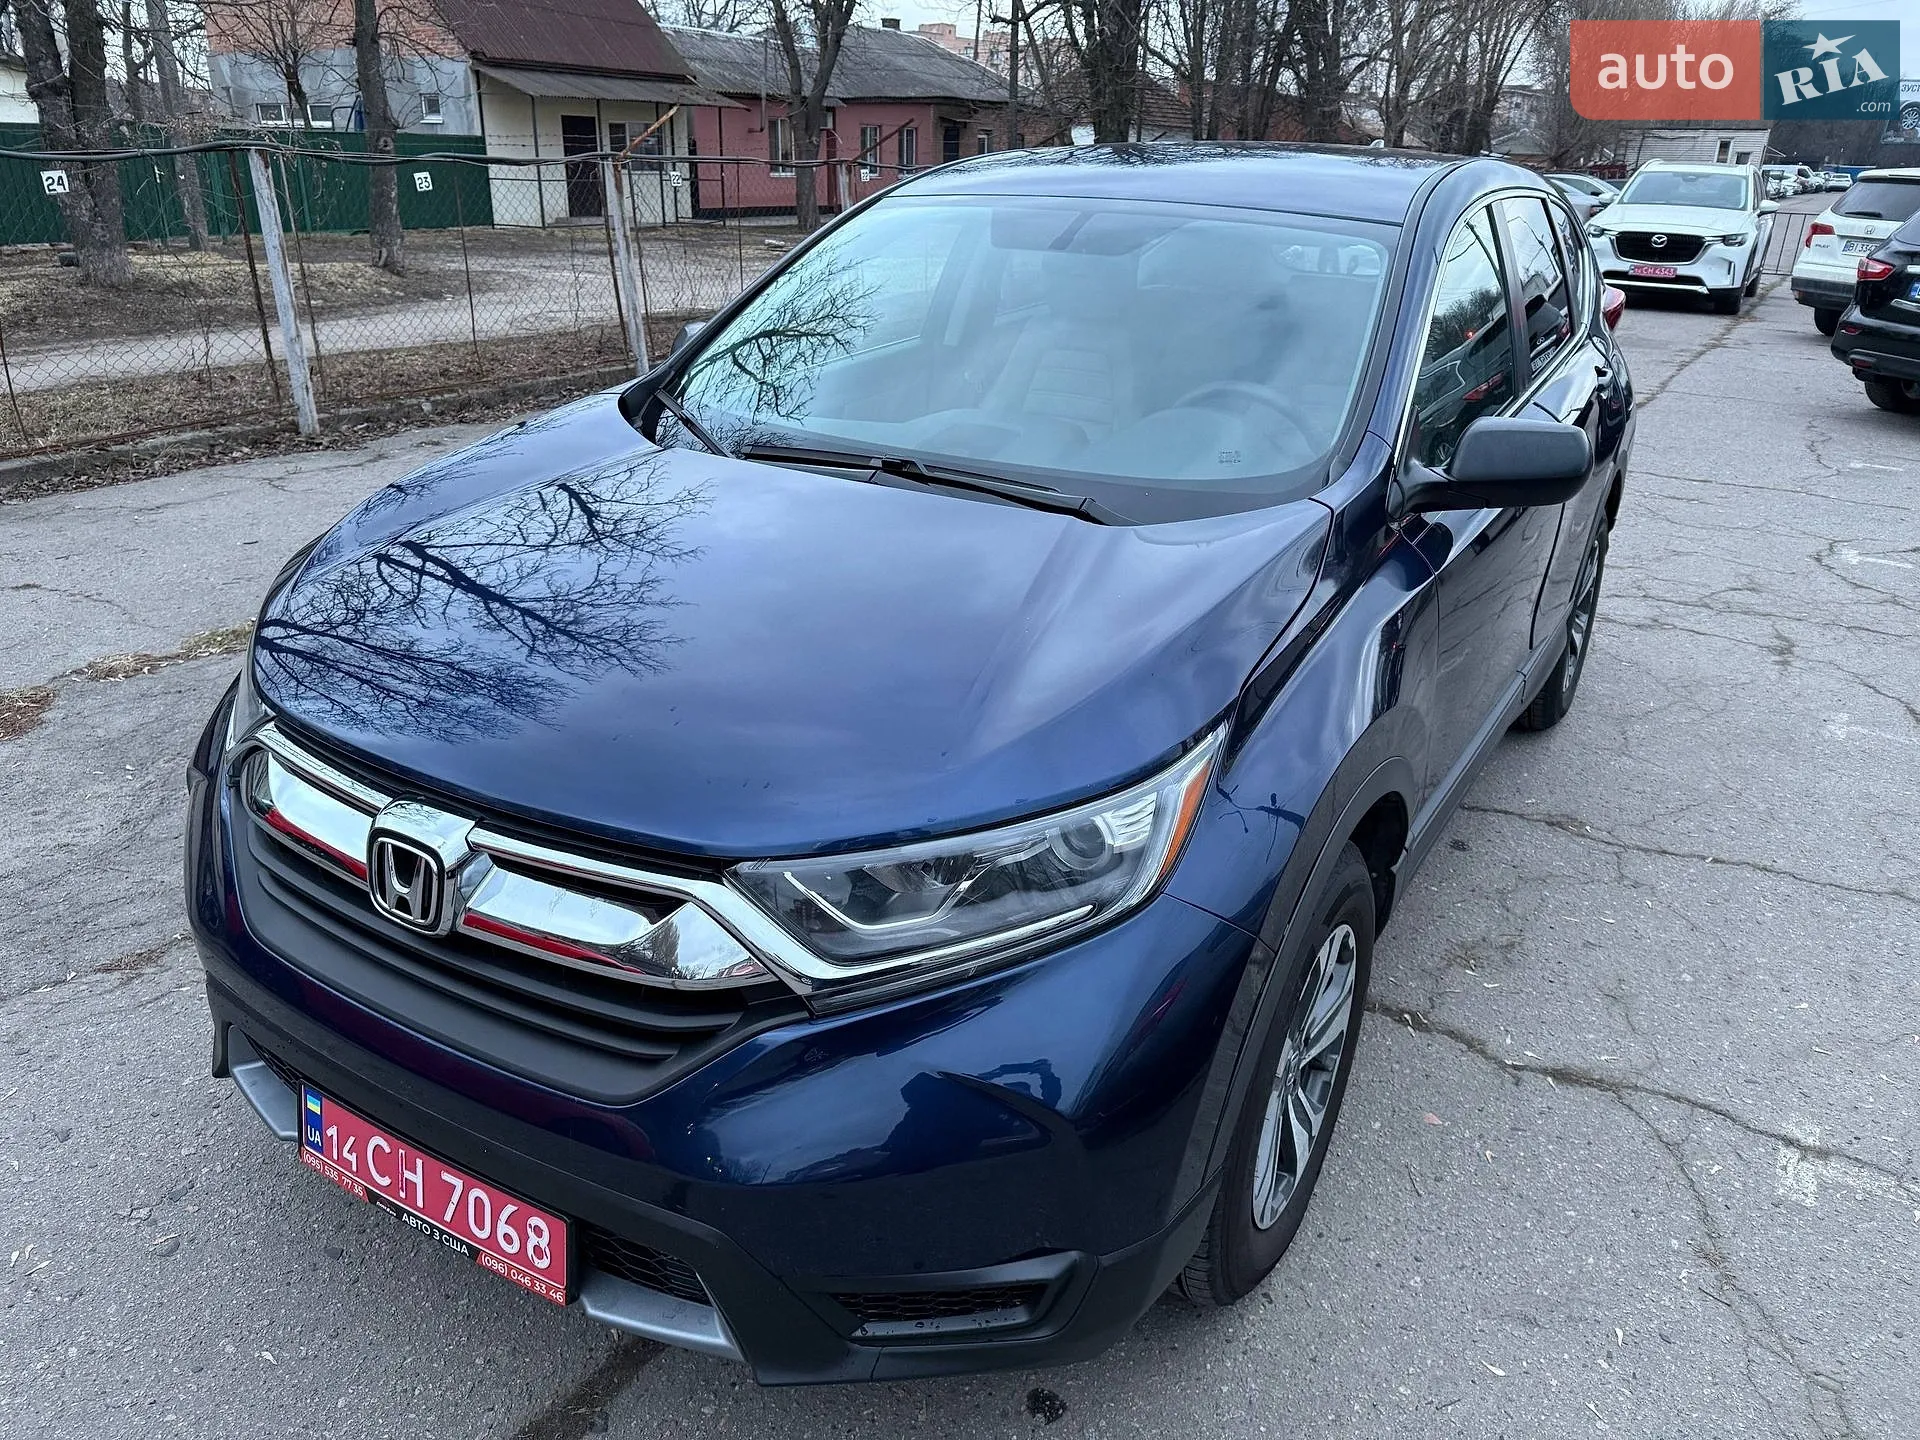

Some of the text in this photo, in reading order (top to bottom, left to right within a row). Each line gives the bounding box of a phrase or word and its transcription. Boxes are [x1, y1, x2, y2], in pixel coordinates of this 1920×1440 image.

[45, 175, 66, 192] 24
[417, 176, 431, 189] 23
[306, 1125, 322, 1147] UA
[303, 1150, 364, 1197] (095) 535 77 35
[325, 1125, 551, 1269] 14 CH 7068
[401, 1212, 431, 1235] АВТО
[442, 1234, 470, 1257] США
[481, 1252, 564, 1303] (096) 046 33 46
